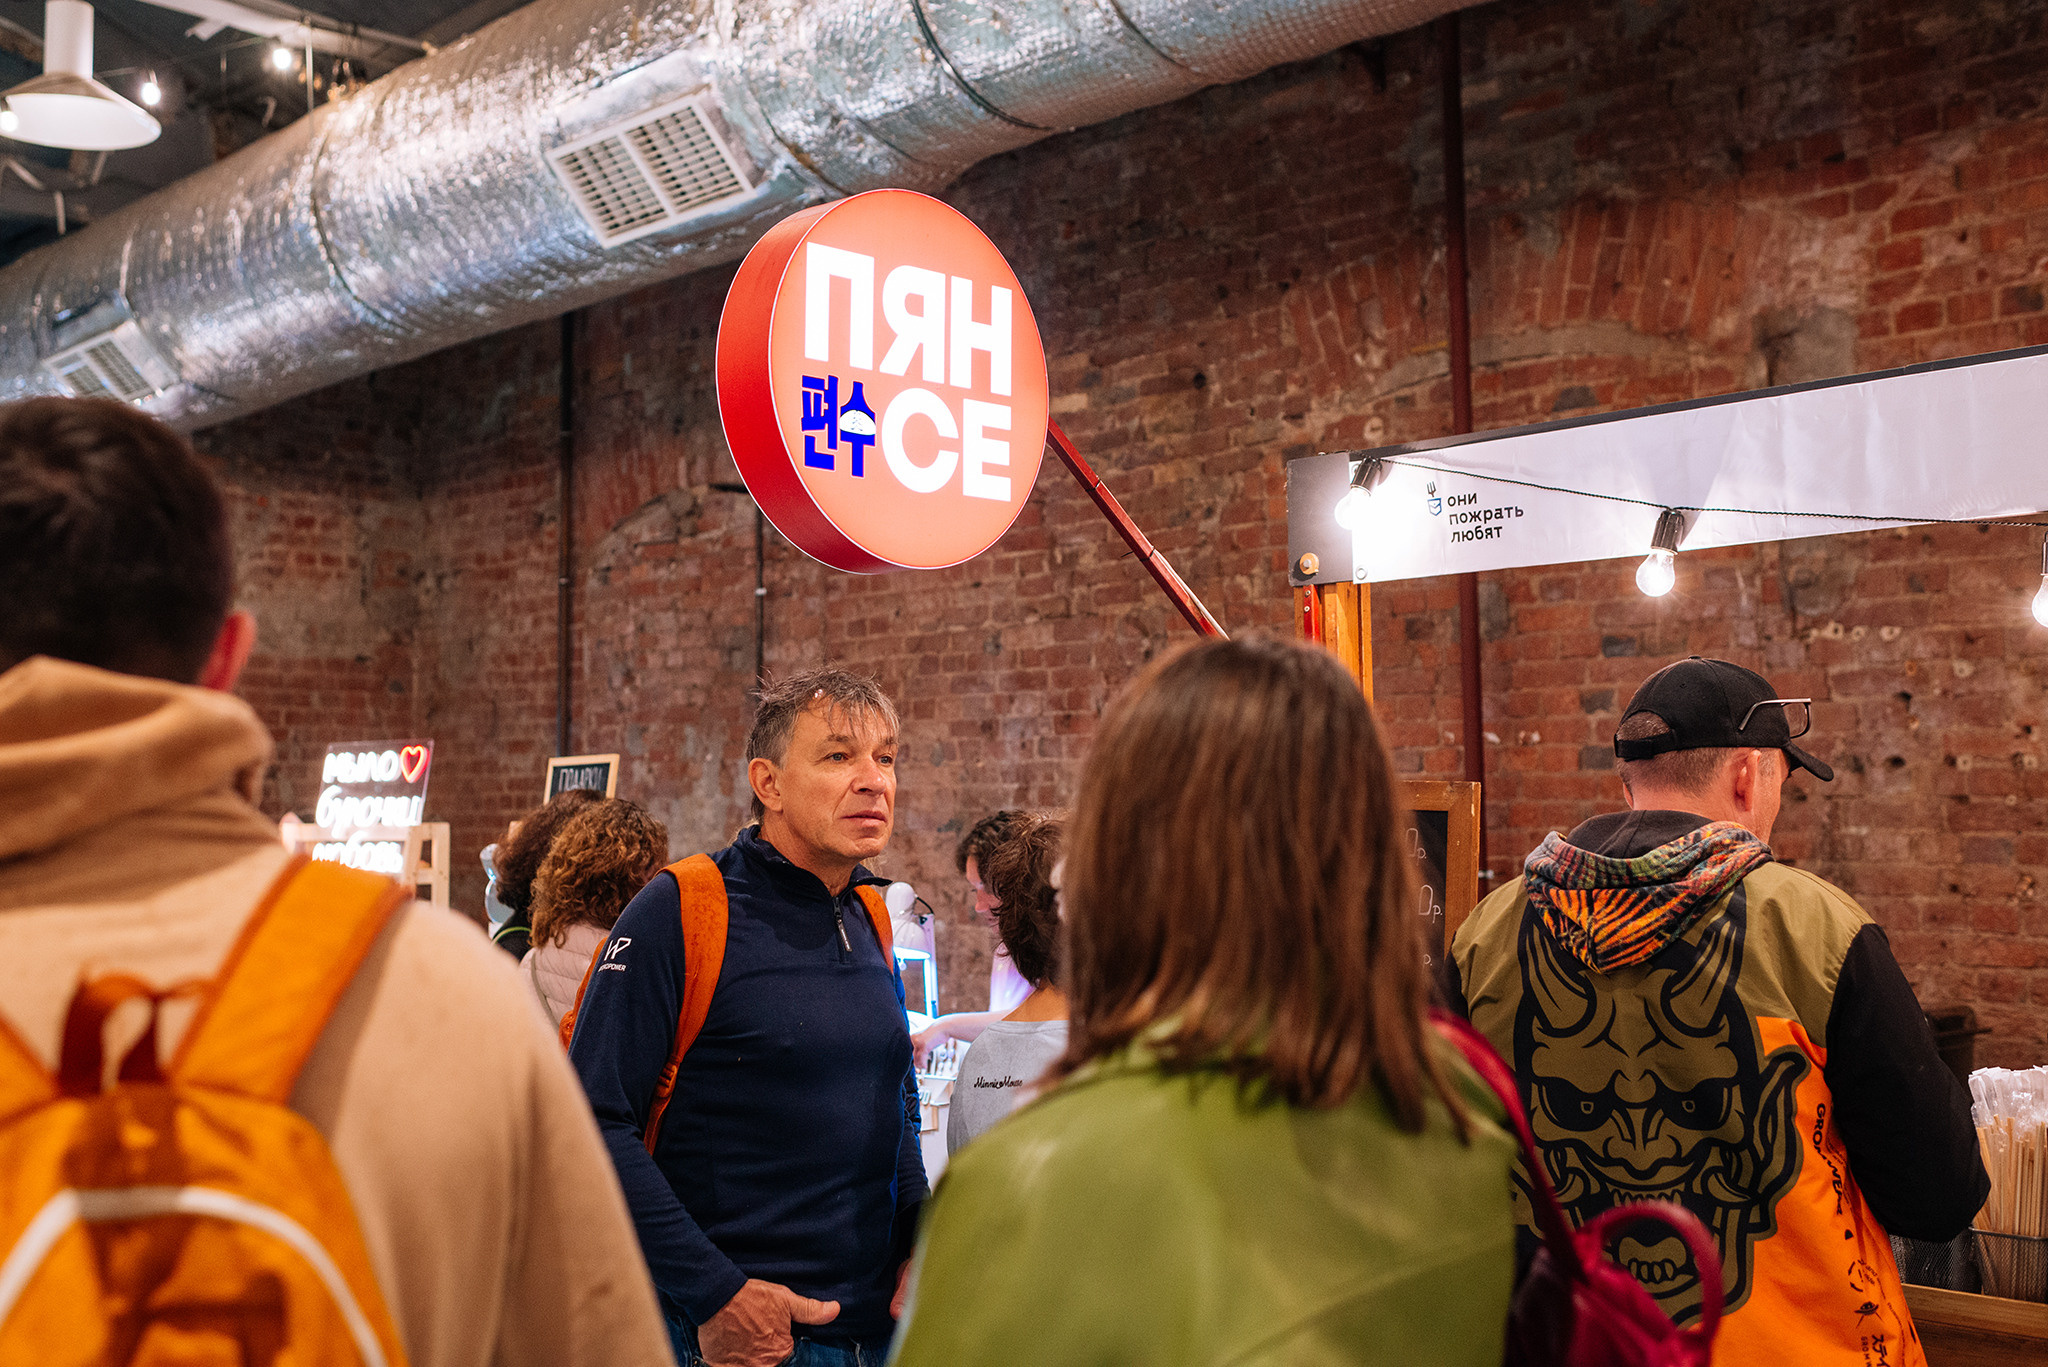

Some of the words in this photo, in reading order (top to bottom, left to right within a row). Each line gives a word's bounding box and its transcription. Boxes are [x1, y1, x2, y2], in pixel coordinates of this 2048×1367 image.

[804, 241, 1013, 397] ПЯН
[801, 374, 876, 478] 편수
[881, 387, 1012, 502] СЕ
[1447, 492, 1478, 507] они
[1449, 505, 1524, 524] пожрать
[1450, 524, 1503, 543] любят
[322, 750, 402, 783] мыло
